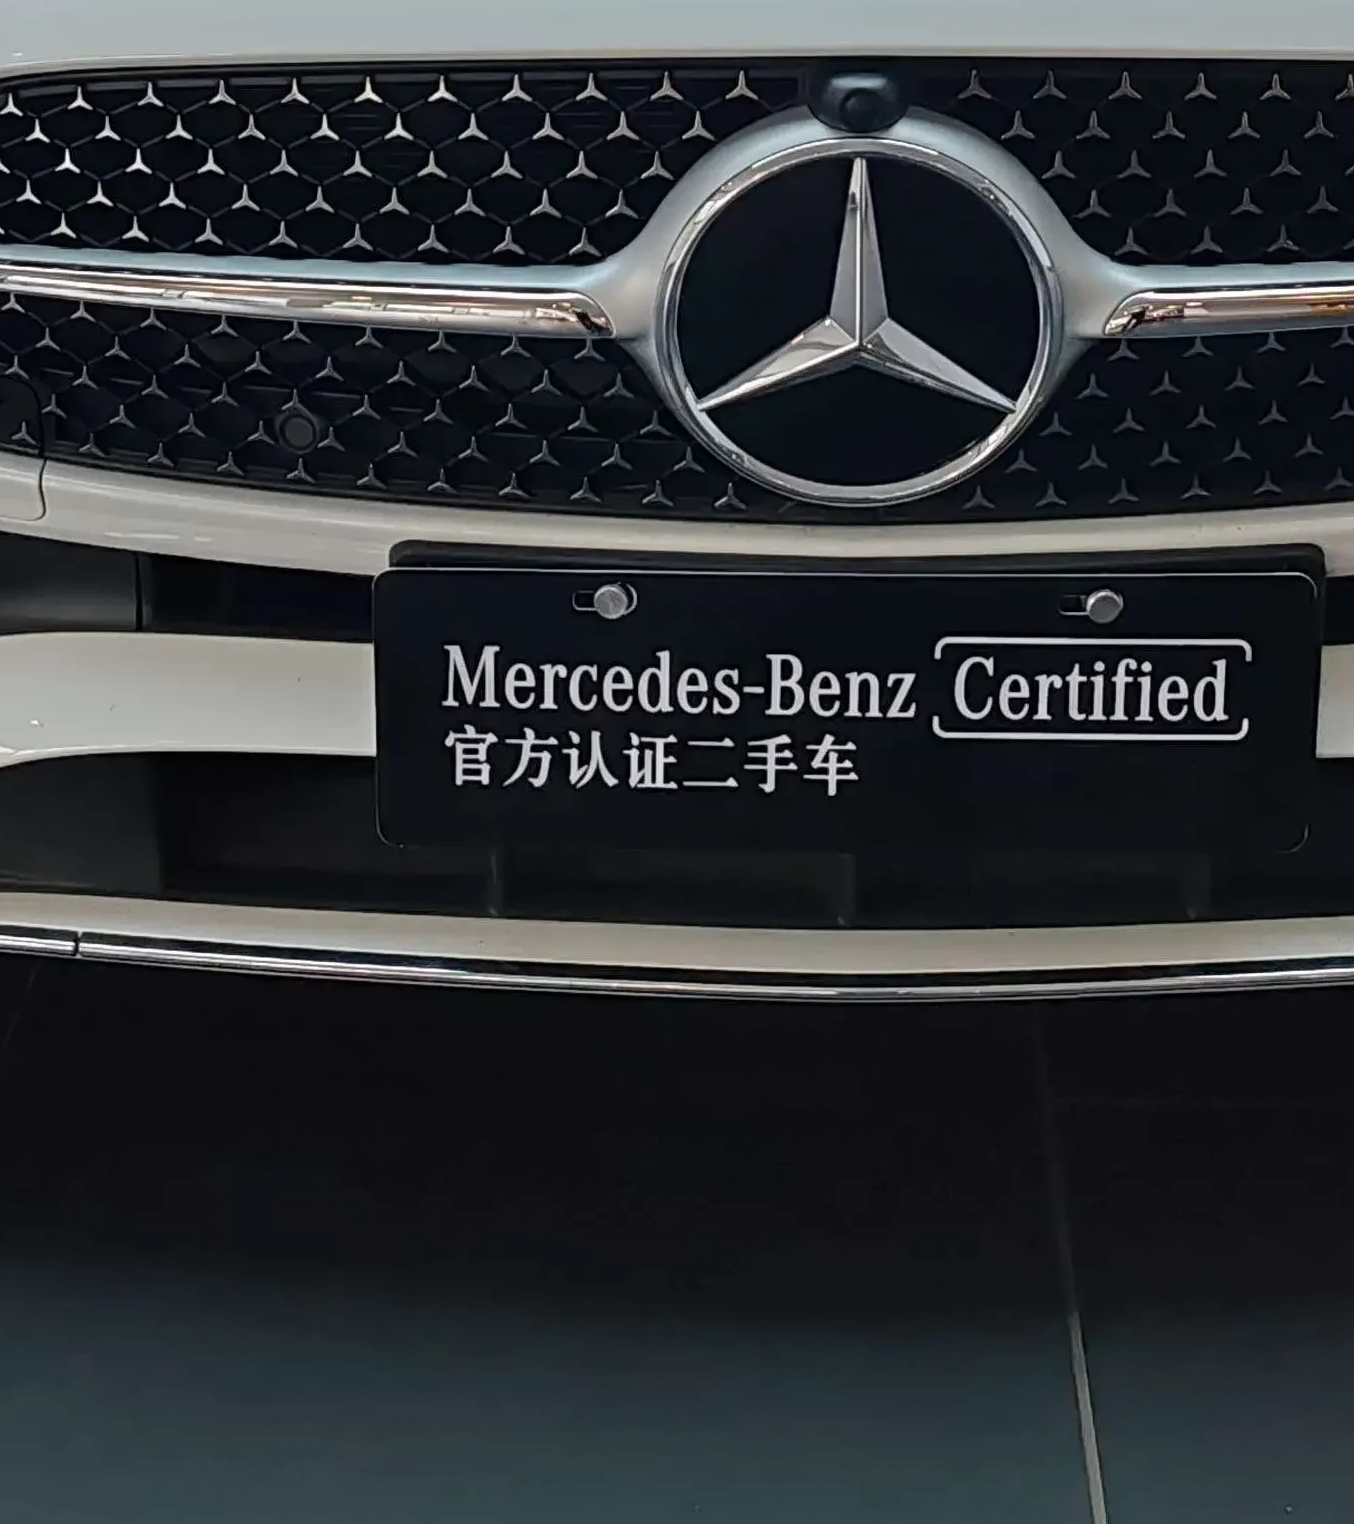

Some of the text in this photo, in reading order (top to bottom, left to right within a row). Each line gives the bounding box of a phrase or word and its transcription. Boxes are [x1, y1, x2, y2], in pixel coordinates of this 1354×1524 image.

[442, 644, 1230, 723] Mercedes-Benz Certified
[444, 724, 859, 796] 官方认证二手车
